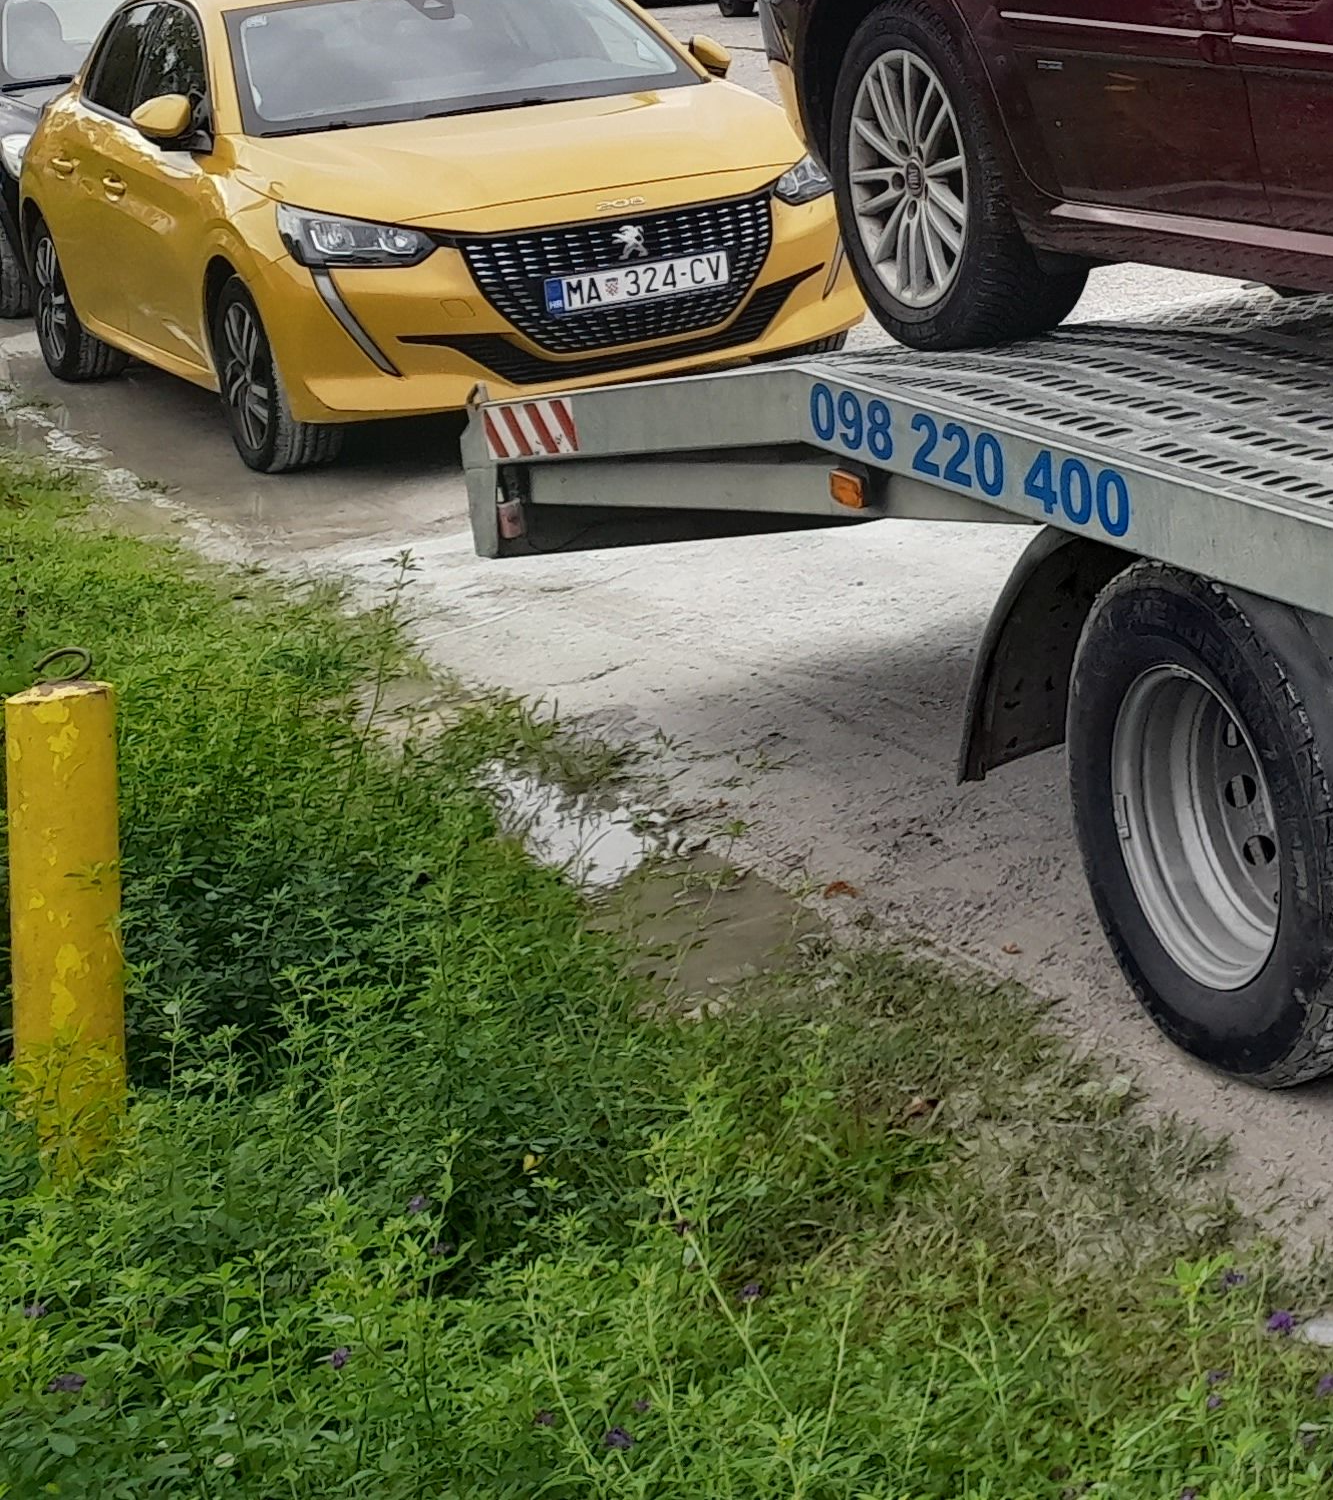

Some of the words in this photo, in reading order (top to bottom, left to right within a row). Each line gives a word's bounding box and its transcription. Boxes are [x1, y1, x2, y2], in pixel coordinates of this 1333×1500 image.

[596, 195, 646, 211] 208
[566, 278, 602, 307] MA
[624, 255, 721, 297] 324-CV
[810, 382, 894, 461] 098
[910, 413, 1004, 497] 220
[1023, 449, 1130, 537] 400
